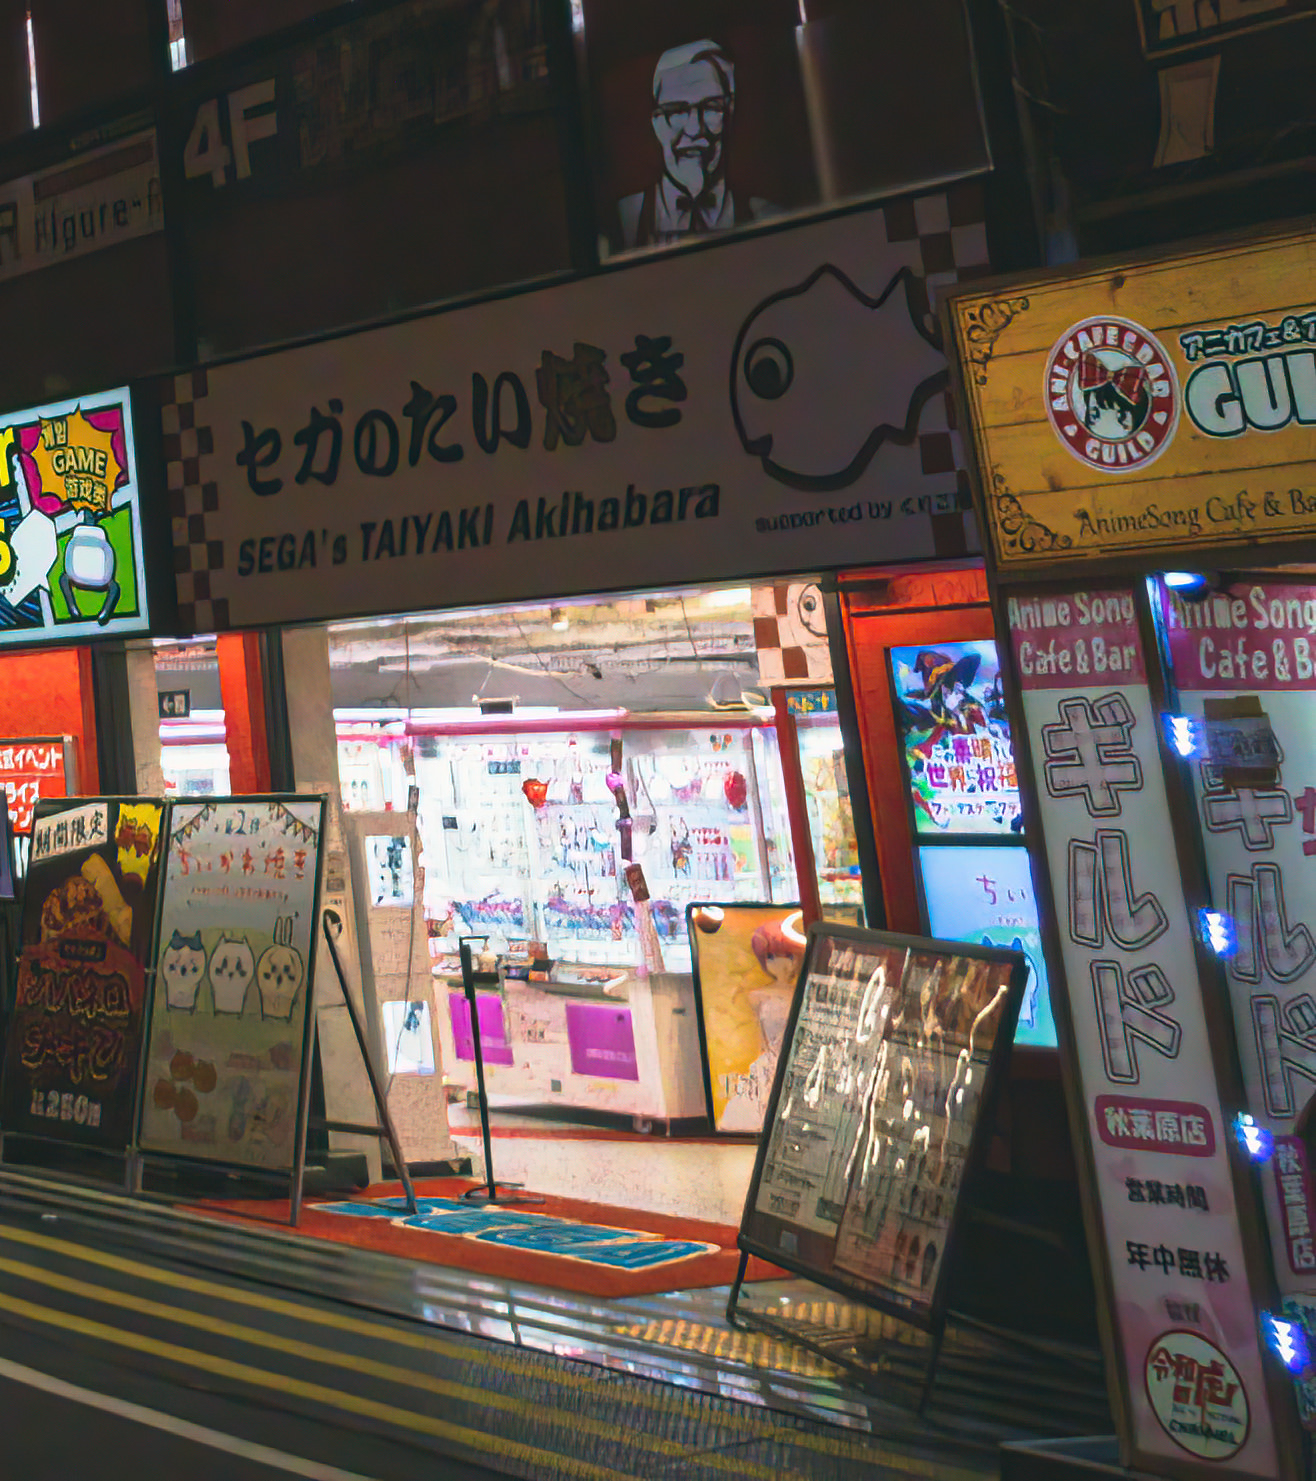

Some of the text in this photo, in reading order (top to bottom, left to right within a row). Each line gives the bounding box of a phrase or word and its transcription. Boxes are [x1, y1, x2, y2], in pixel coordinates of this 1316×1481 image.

[184, 77, 279, 189] 4F
[236, 332, 689, 497] セガのたい焼き
[52, 447, 107, 477] GAME
[1084, 431, 1156, 465] GUILD
[239, 481, 723, 579] SEGA's TAIYAKI Akihabara
[1009, 590, 1136, 631] Anime Song
[1041, 692, 1183, 1086] ギルド
[1102, 1104, 1209, 1148] 秋葉原店
[1124, 1176, 1210, 1213] 営業時間
[1125, 1240, 1231, 1283] 年中無休
